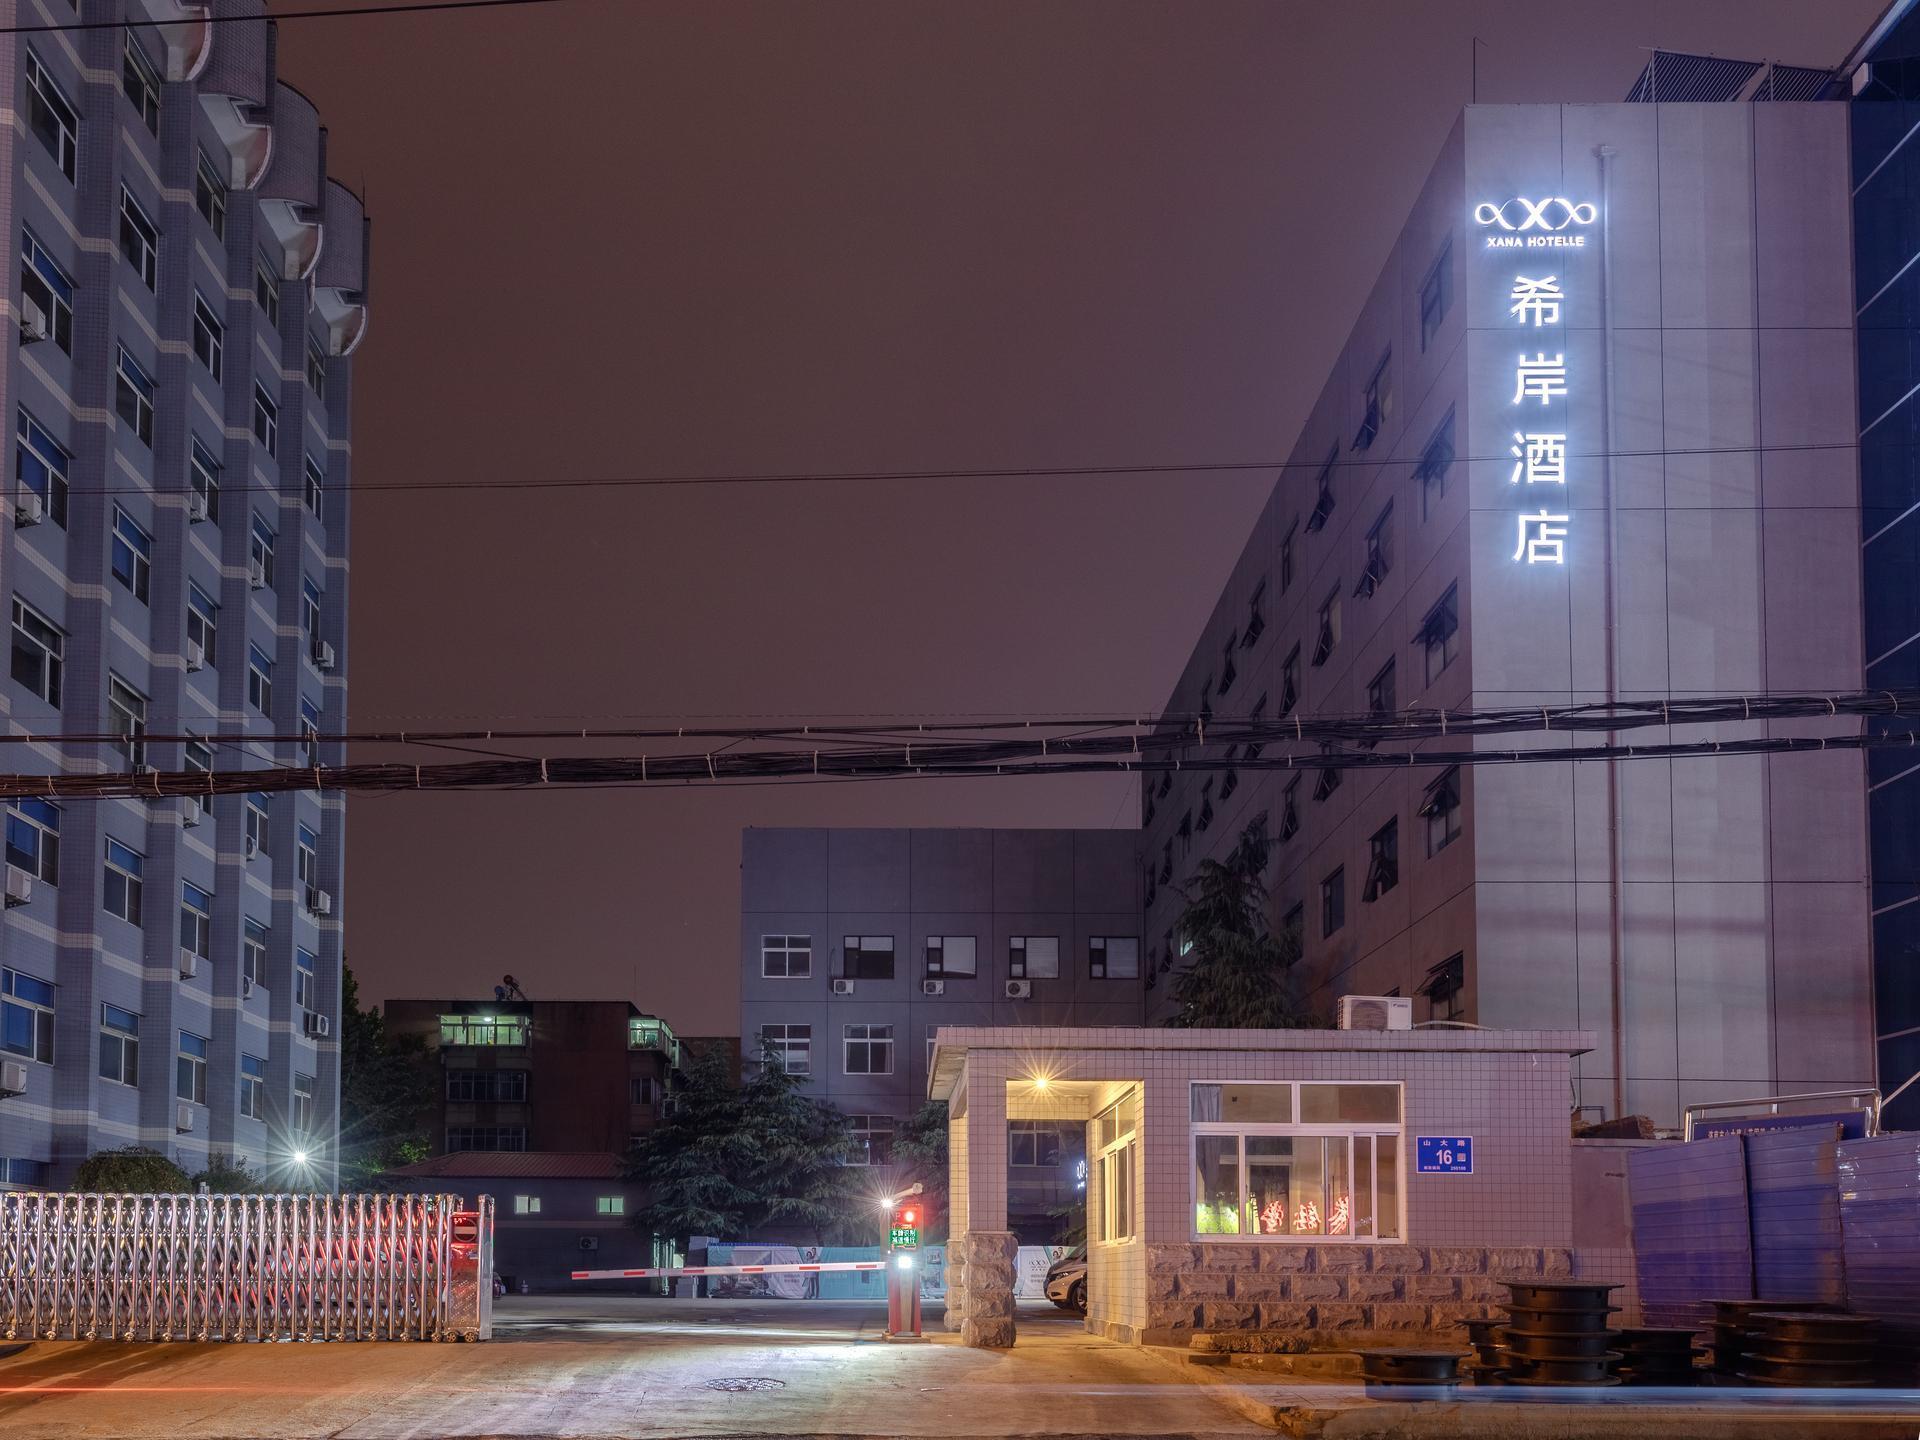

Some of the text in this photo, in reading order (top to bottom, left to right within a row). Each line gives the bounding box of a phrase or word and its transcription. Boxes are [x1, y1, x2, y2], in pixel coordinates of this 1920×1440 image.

[1487, 235, 1585, 248] XANA HOTELLE
[1510, 275, 1569, 565] 希岸酒店
[1423, 1139, 1465, 1147] 山大路
[1436, 1149, 1453, 1165] 16
